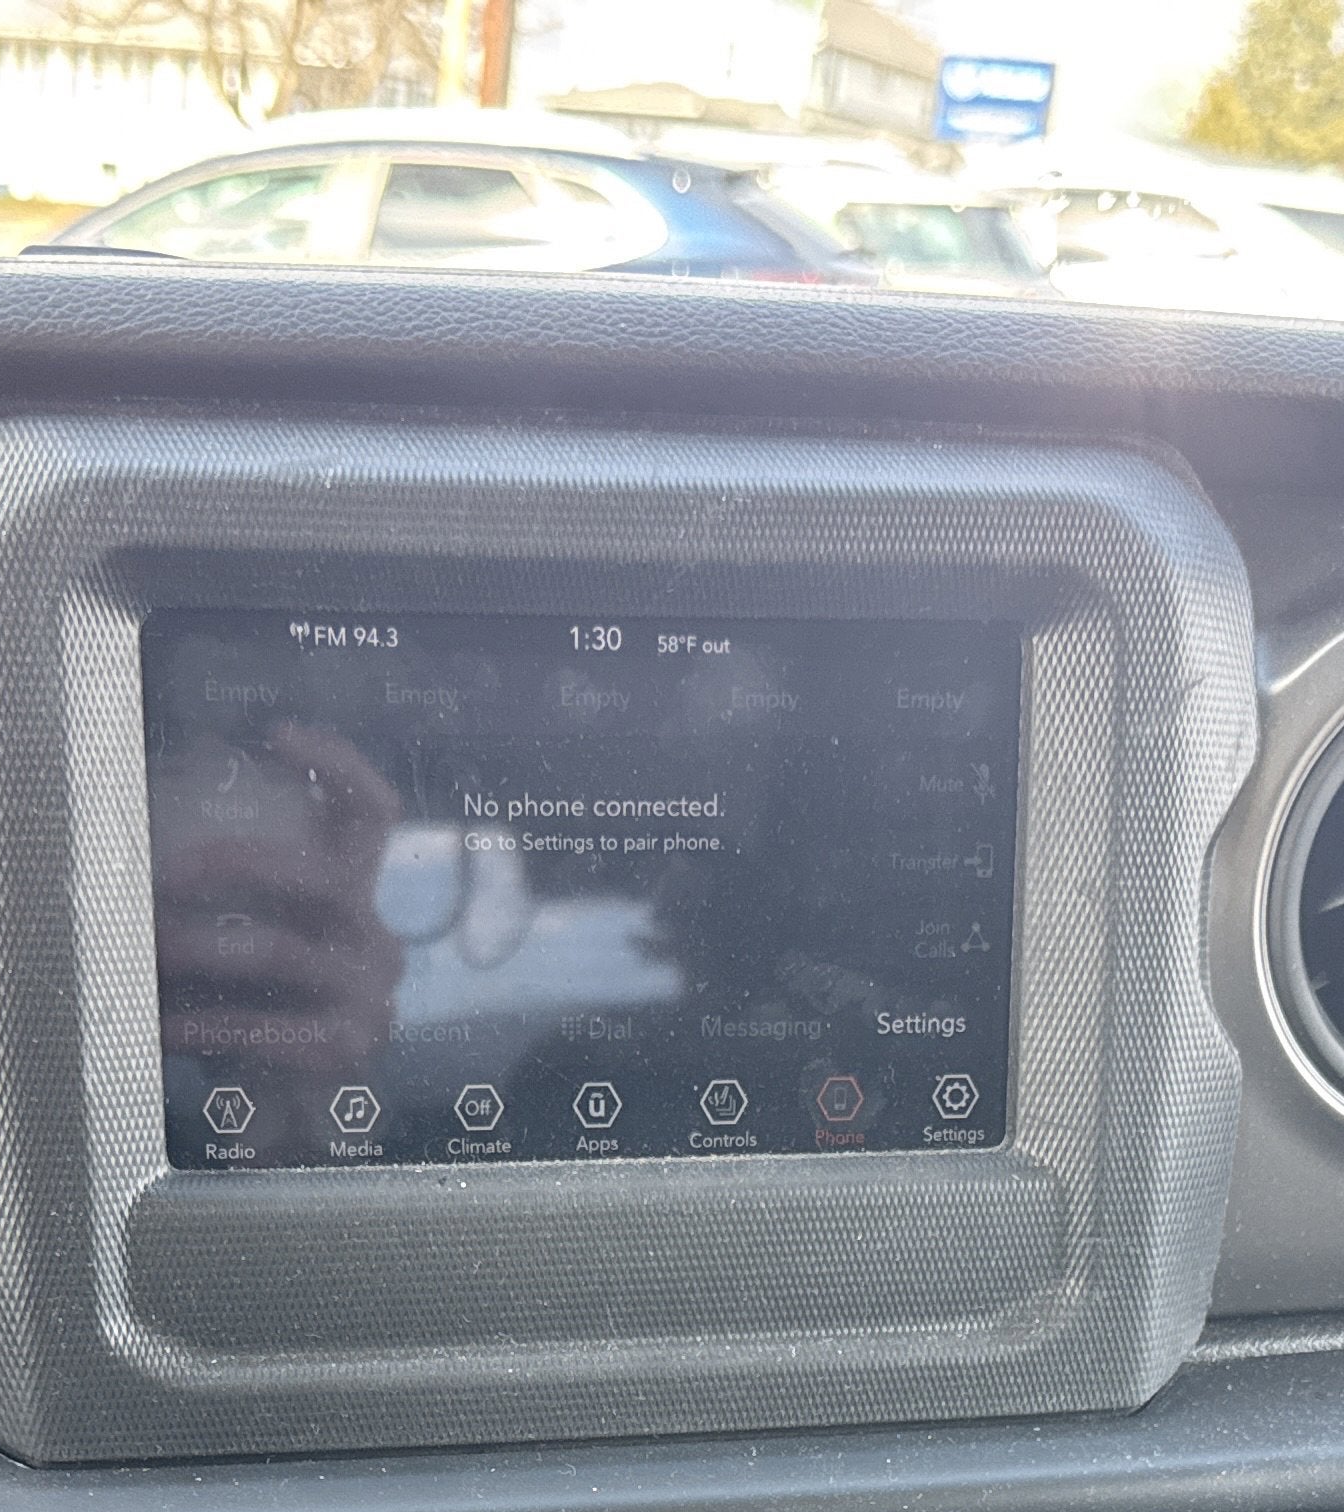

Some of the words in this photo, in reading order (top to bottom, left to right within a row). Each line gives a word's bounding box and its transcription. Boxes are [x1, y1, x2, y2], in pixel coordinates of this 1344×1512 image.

[314, 627, 346, 646] FM
[354, 628, 398, 647] 94.3
[569, 626, 623, 651] 1:30
[657, 636, 697, 653] 58°F
[702, 639, 731, 654] out
[206, 681, 279, 705] Empty
[385, 683, 457, 707] Empty
[560, 686, 630, 711] Empty
[732, 687, 799, 710] Empty
[897, 688, 964, 711] Empty
[919, 775, 964, 794] Mute
[464, 793, 499, 817] No
[508, 792, 585, 821] phone
[593, 793, 725, 817] connected.
[464, 832, 492, 850] Go
[498, 834, 516, 850] to
[523, 833, 594, 854] Settings
[600, 834, 618, 850] to
[624, 833, 657, 854] pair
[663, 832, 725, 854] phone.
[890, 852, 957, 871] Transfer
[915, 921, 950, 936] Join
[218, 936, 254, 956] End
[914, 942, 956, 959] Calls
[183, 1021, 328, 1044] Phonebook
[388, 1021, 471, 1042] Recent
[589, 1018, 632, 1040] Dial
[701, 1016, 821, 1040] Messaging
[876, 1012, 966, 1038] Settings
[465, 1101, 492, 1117] Off
[576, 1136, 619, 1154] Apps
[689, 1132, 757, 1150] Controls
[816, 1129, 865, 1146] Phone
[923, 1126, 985, 1144] Settings
[205, 1143, 256, 1160] Radio
[330, 1141, 384, 1158] Media
[447, 1138, 512, 1155] Climate
